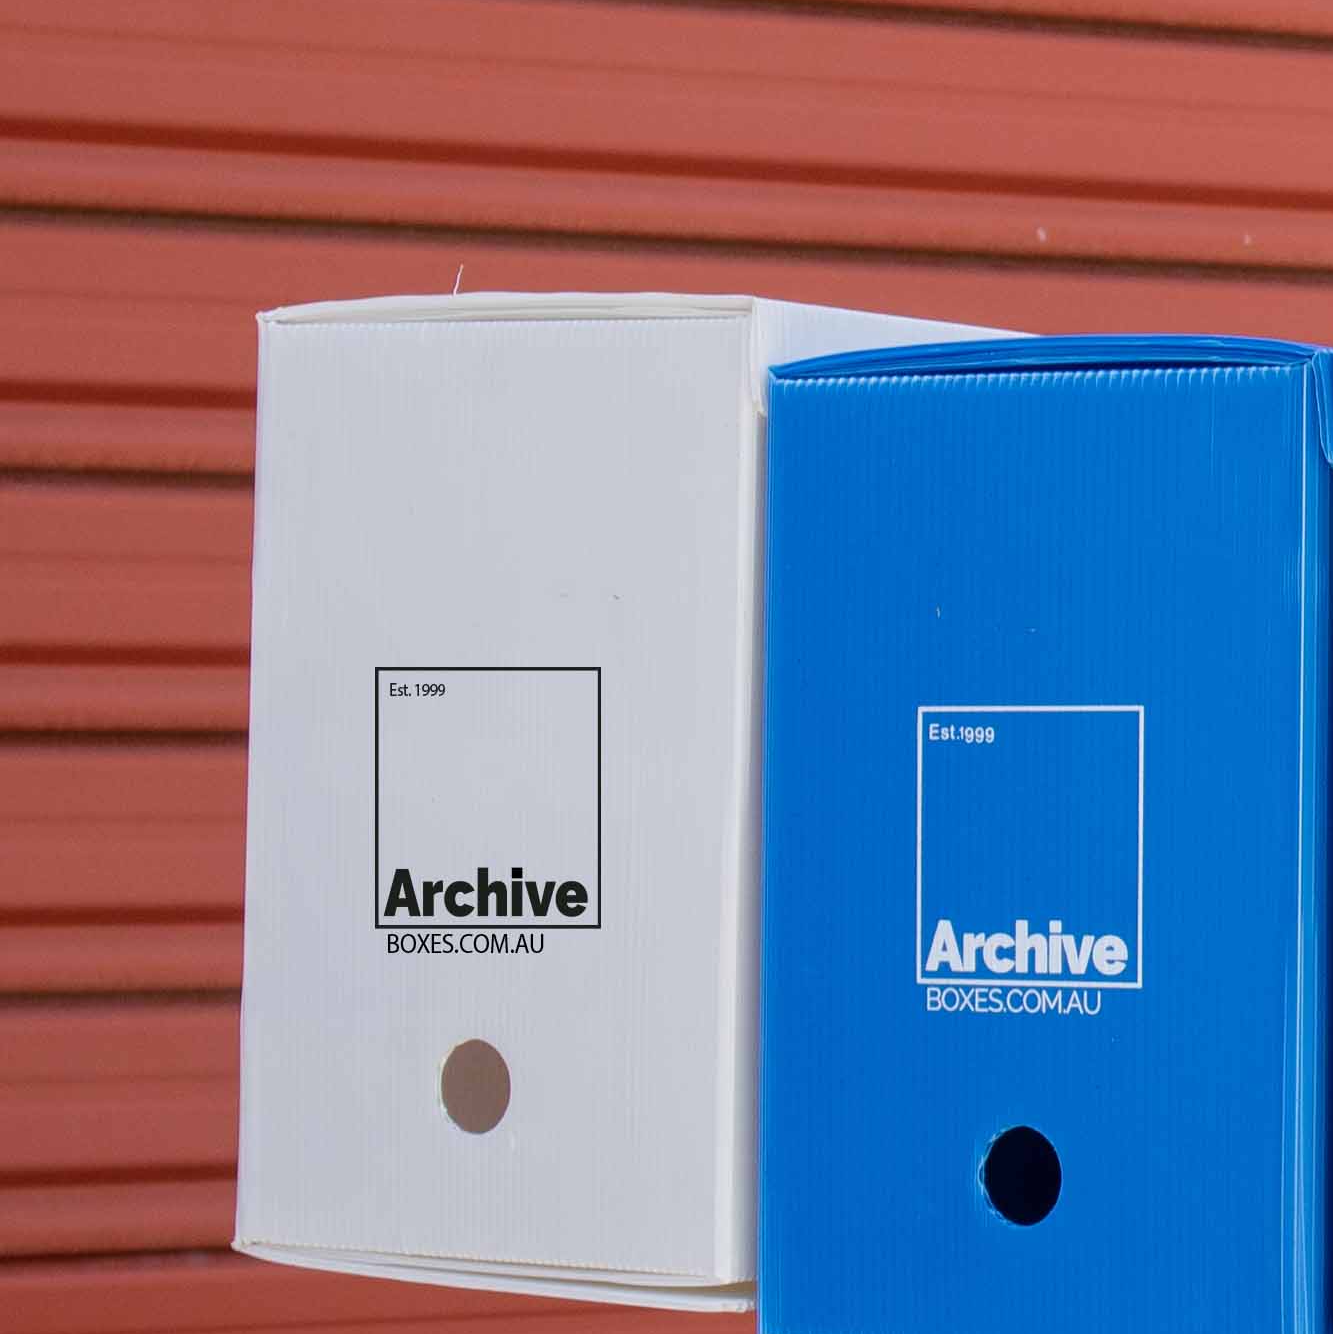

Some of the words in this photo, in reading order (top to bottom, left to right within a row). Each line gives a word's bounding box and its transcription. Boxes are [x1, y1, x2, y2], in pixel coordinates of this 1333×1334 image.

[389, 683, 412, 697] Est.
[415, 683, 446, 697] 1999
[383, 867, 589, 918] Archive
[387, 933, 544, 954] BOXES.COM.AU
[925, 919, 1129, 976] Archive
[926, 987, 1101, 1015] BOXES.COM.AU
